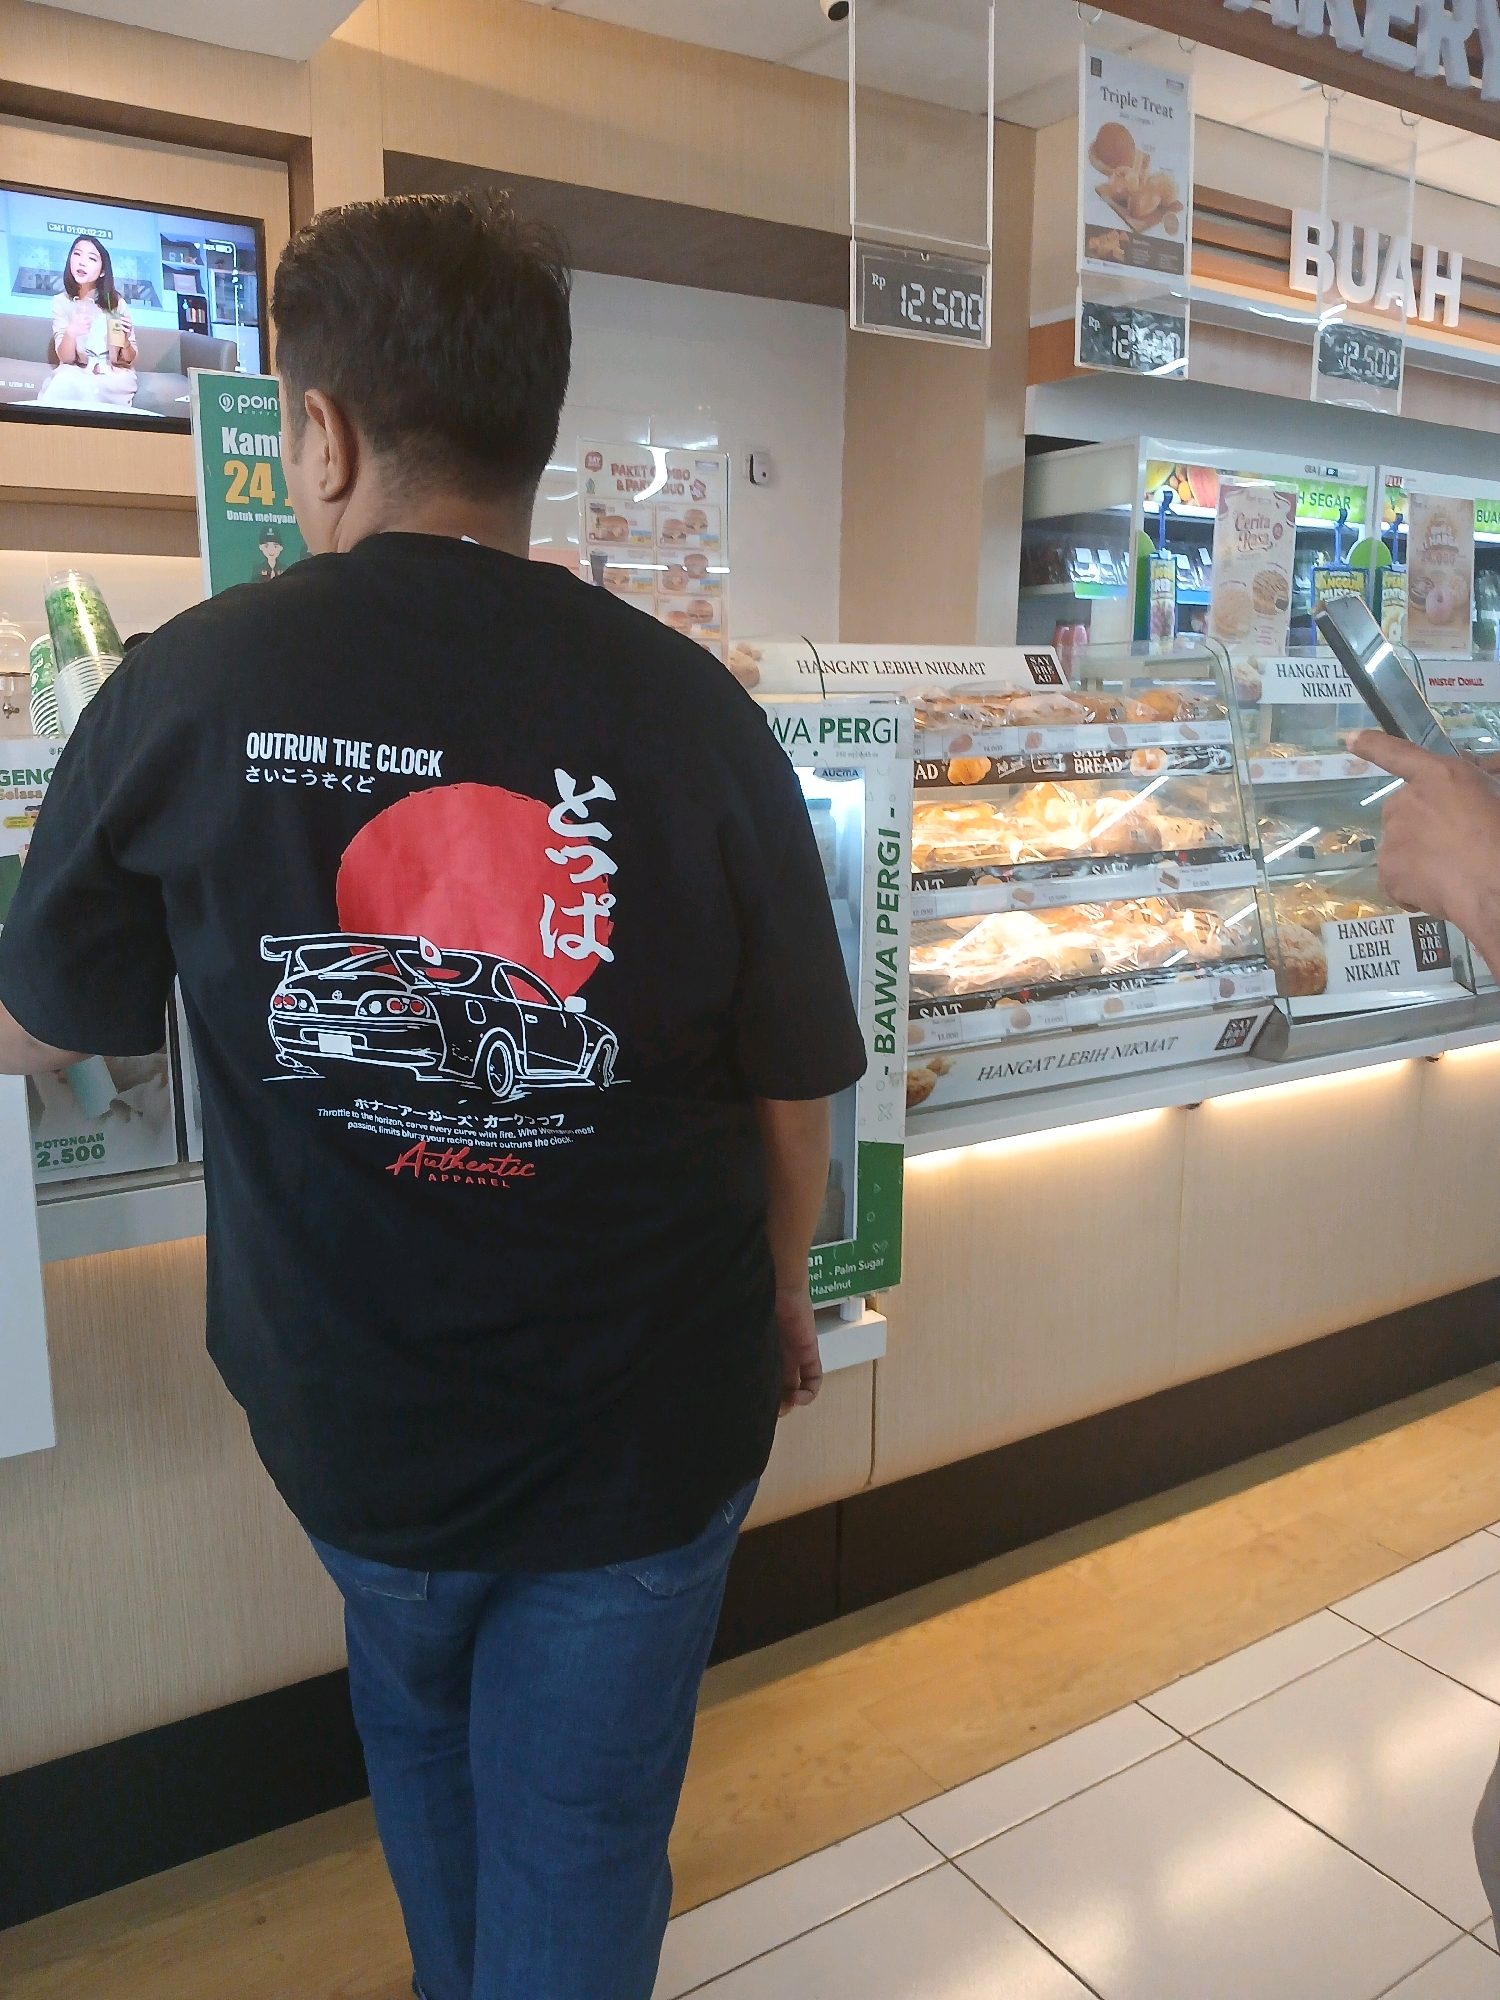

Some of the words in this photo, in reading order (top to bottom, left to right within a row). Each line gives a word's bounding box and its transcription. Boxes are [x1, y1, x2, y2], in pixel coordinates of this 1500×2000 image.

[1100, 85, 1138, 110] Triple
[1142, 96, 1174, 119] Treat
[1289, 207, 1463, 327] BUAH
[871, 272, 886, 290] Rp
[900, 282, 983, 331] 12.500
[1342, 341, 1398, 380] 12.500
[237, 394, 279, 414] poin
[611, 463, 648, 479] PAKET
[649, 466, 691, 481] CMBO
[223, 459, 276, 506] 24
[1309, 490, 1351, 510] SEGAR
[226, 509, 254, 522] Untuk
[1234, 512, 1271, 532] Cerita
[1476, 508, 1500, 524] BUA
[796, 659, 868, 675] HANGAT
[875, 660, 923, 676] LEBIH
[924, 661, 986, 676] NIKMAT
[1276, 663, 1330, 680] HANGAT
[1302, 682, 1353, 699] NIKMAT
[771, 717, 812, 745] WA
[819, 717, 899, 744] PERGI
[246, 732, 328, 764] OUTRUN
[333, 738, 373, 770] THE
[376, 744, 444, 778] CLOCK
[1073, 756, 1123, 775] BREAD
[245, 765, 376, 794] さいこうそくど
[540, 767, 619, 963] とっぱ
[1091, 862, 1129, 875] SALT
[876, 826, 901, 936] PERGI
[913, 879, 945, 891] ALT
[1337, 918, 1395, 940] HANGAT
[1417, 922, 1439, 936] SAY
[1349, 940, 1391, 960] LEBIH
[1419, 936, 1441, 950] BRE
[1421, 950, 1438, 965] AD
[1344, 959, 1401, 983] NIKMAT
[1108, 978, 1148, 993] SALT
[873, 946, 898, 1056] BAWA
[919, 1003, 963, 1019] SALT
[976, 1055, 1057, 1082] HANGAT
[1056, 1046, 1110, 1069] LEBIH
[1110, 1036, 1179, 1060] NIKMAT
[317, 1108, 351, 1117] Throttle
[351, 1110, 360, 1119] to
[360, 1112, 374, 1121] the
[429, 1124, 453, 1136] every
[478, 1130, 498, 1139] with
[34, 1132, 105, 1151] POTONGAN
[425, 1135, 445, 1143] your
[36, 1143, 106, 1169] 2.500
[385, 1140, 536, 1178] Authentic
[428, 1173, 511, 1189] APPAREL
[834, 1263, 857, 1276] Palm
[858, 1257, 885, 1272] Sugar
[810, 1279, 852, 1297] Hazelnut
